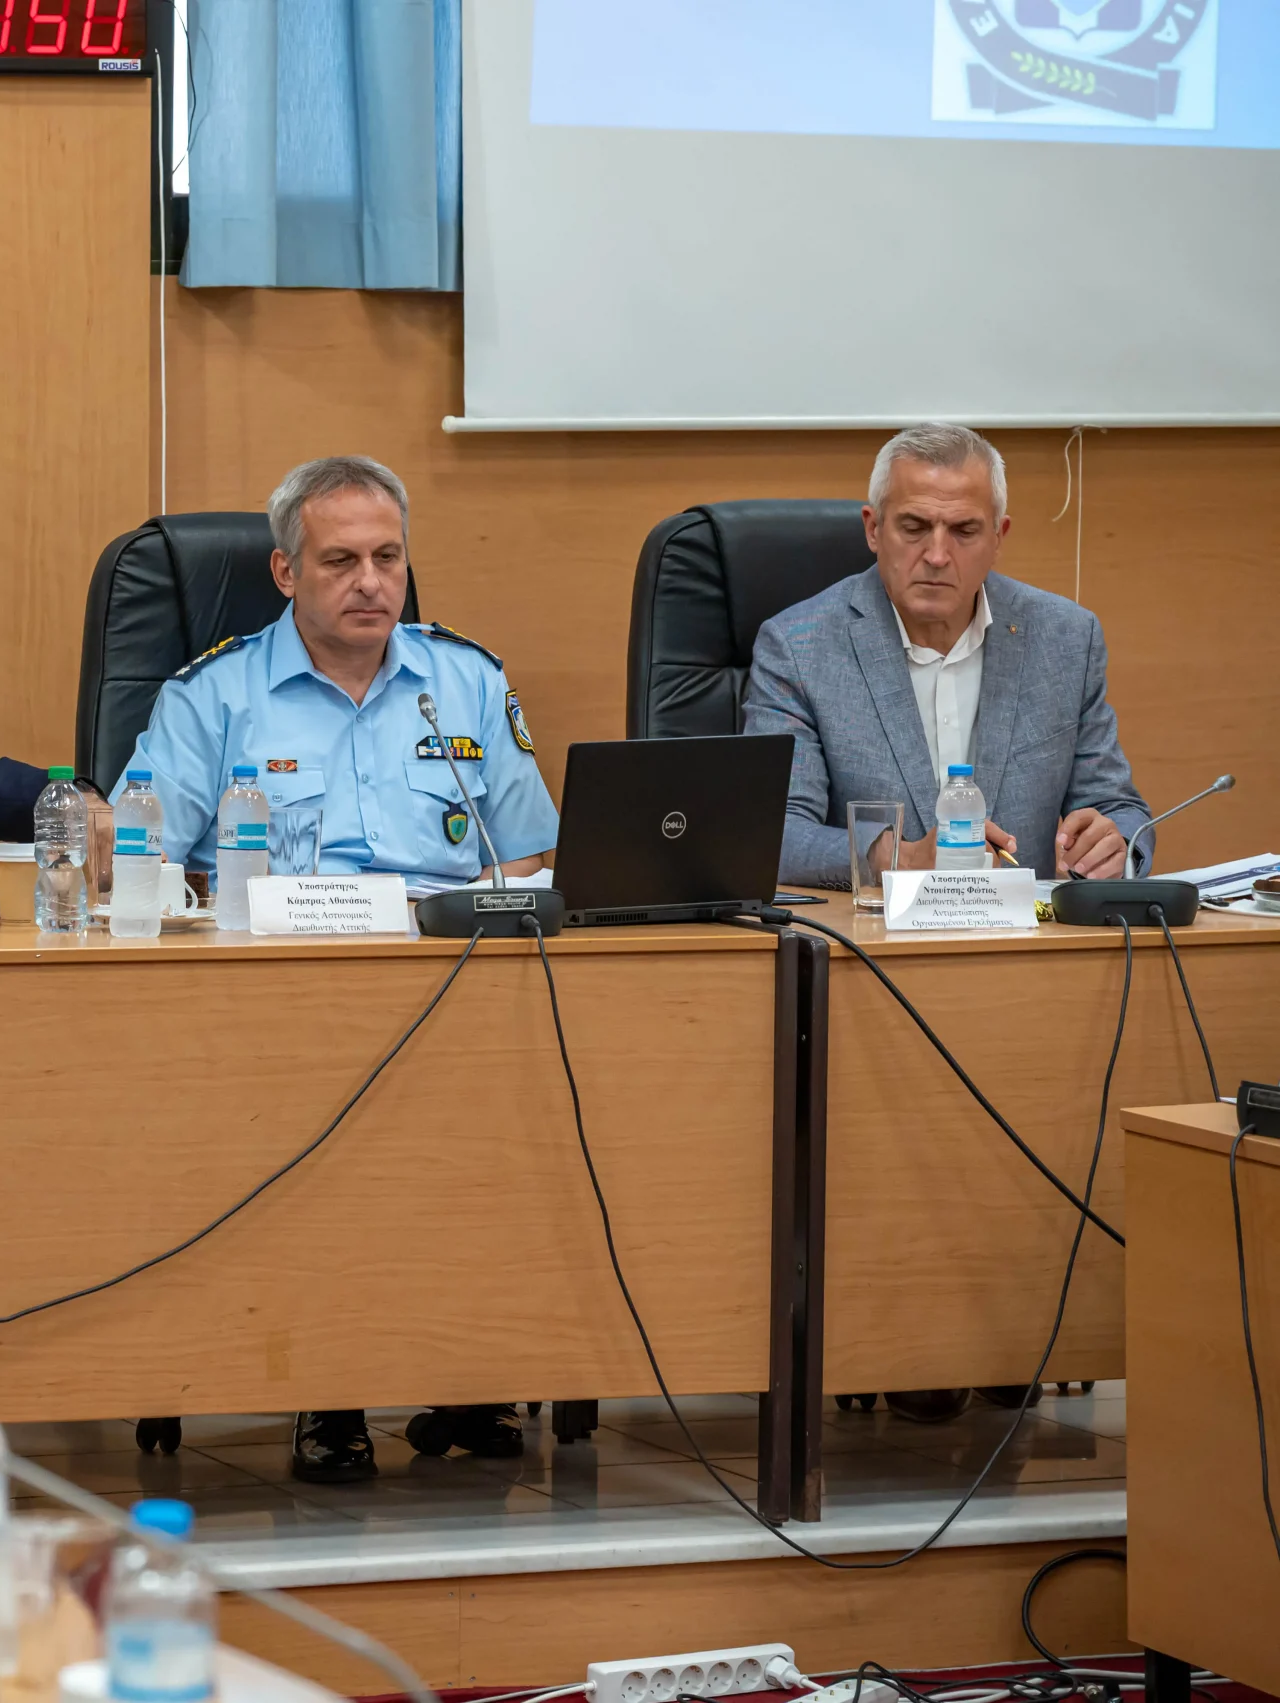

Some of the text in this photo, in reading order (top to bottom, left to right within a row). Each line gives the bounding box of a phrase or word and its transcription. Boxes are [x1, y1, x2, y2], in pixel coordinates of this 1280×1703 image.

[100, 61, 140, 71] ROUSIS
[665, 821, 684, 830] DELL
[931, 875, 990, 884] Υποστράτηγος
[297, 882, 359, 892] Υποστράτηγος
[967, 886, 998, 895] Φώτιος
[287, 896, 372, 906] Κάμπρας Αθανάσιος
[916, 898, 958, 907] Διευθυντής
[288, 911, 373, 921] Γενικός Αστυνομικός
[292, 923, 371, 934] Διευθυντής Αττικής
